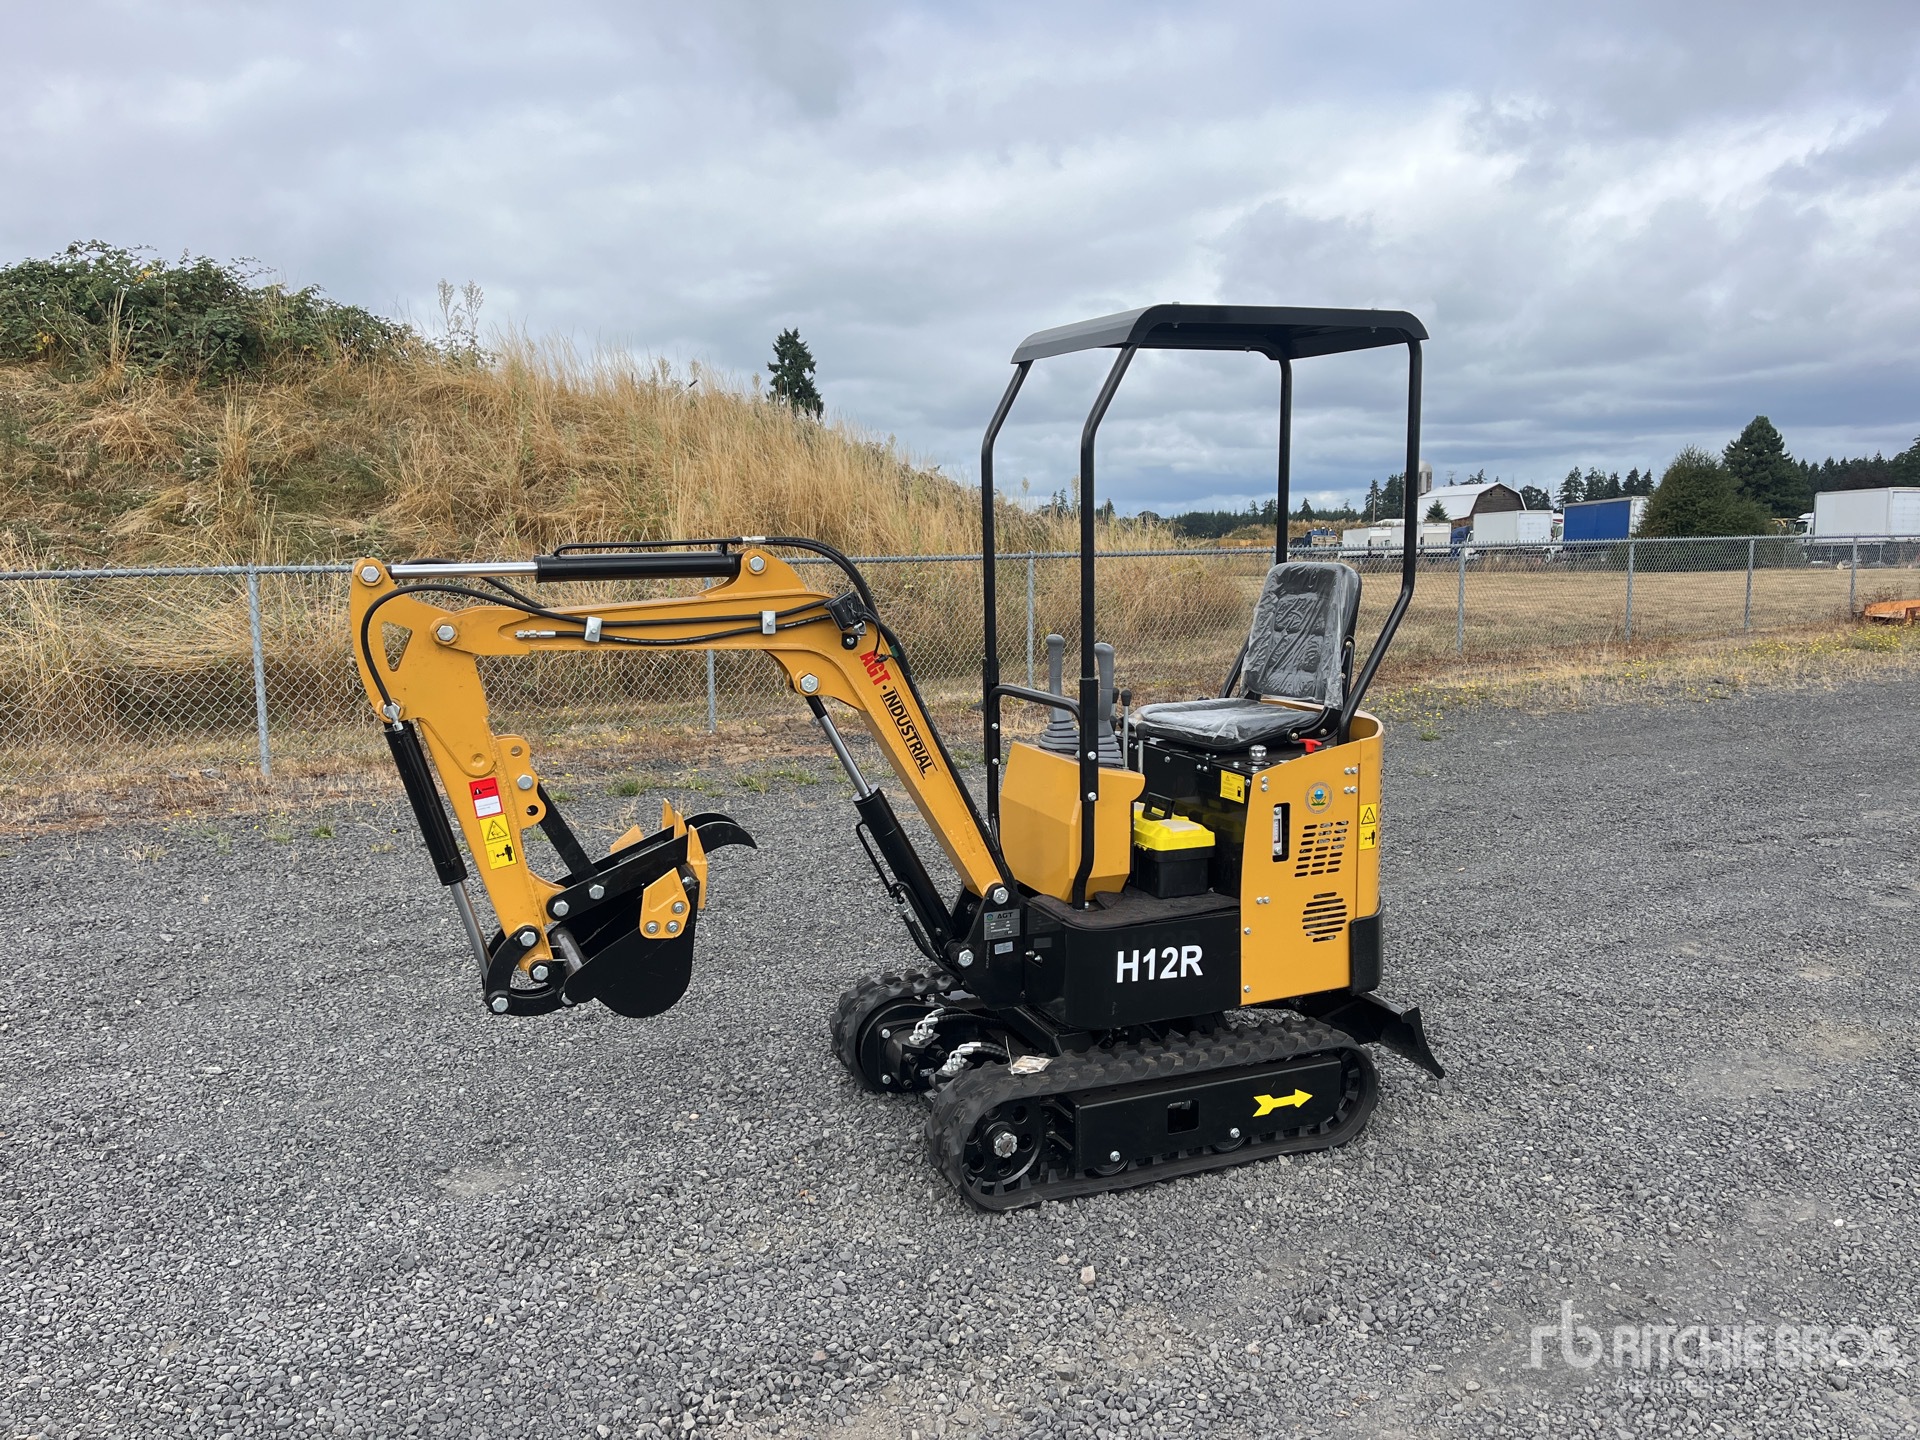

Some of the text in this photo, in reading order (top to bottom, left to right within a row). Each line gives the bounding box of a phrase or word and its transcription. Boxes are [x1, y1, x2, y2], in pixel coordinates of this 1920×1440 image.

[860, 650, 933, 774] AGT INDUSTRIAL
[996, 911, 1013, 919] AGT
[1116, 945, 1204, 984] H12R
